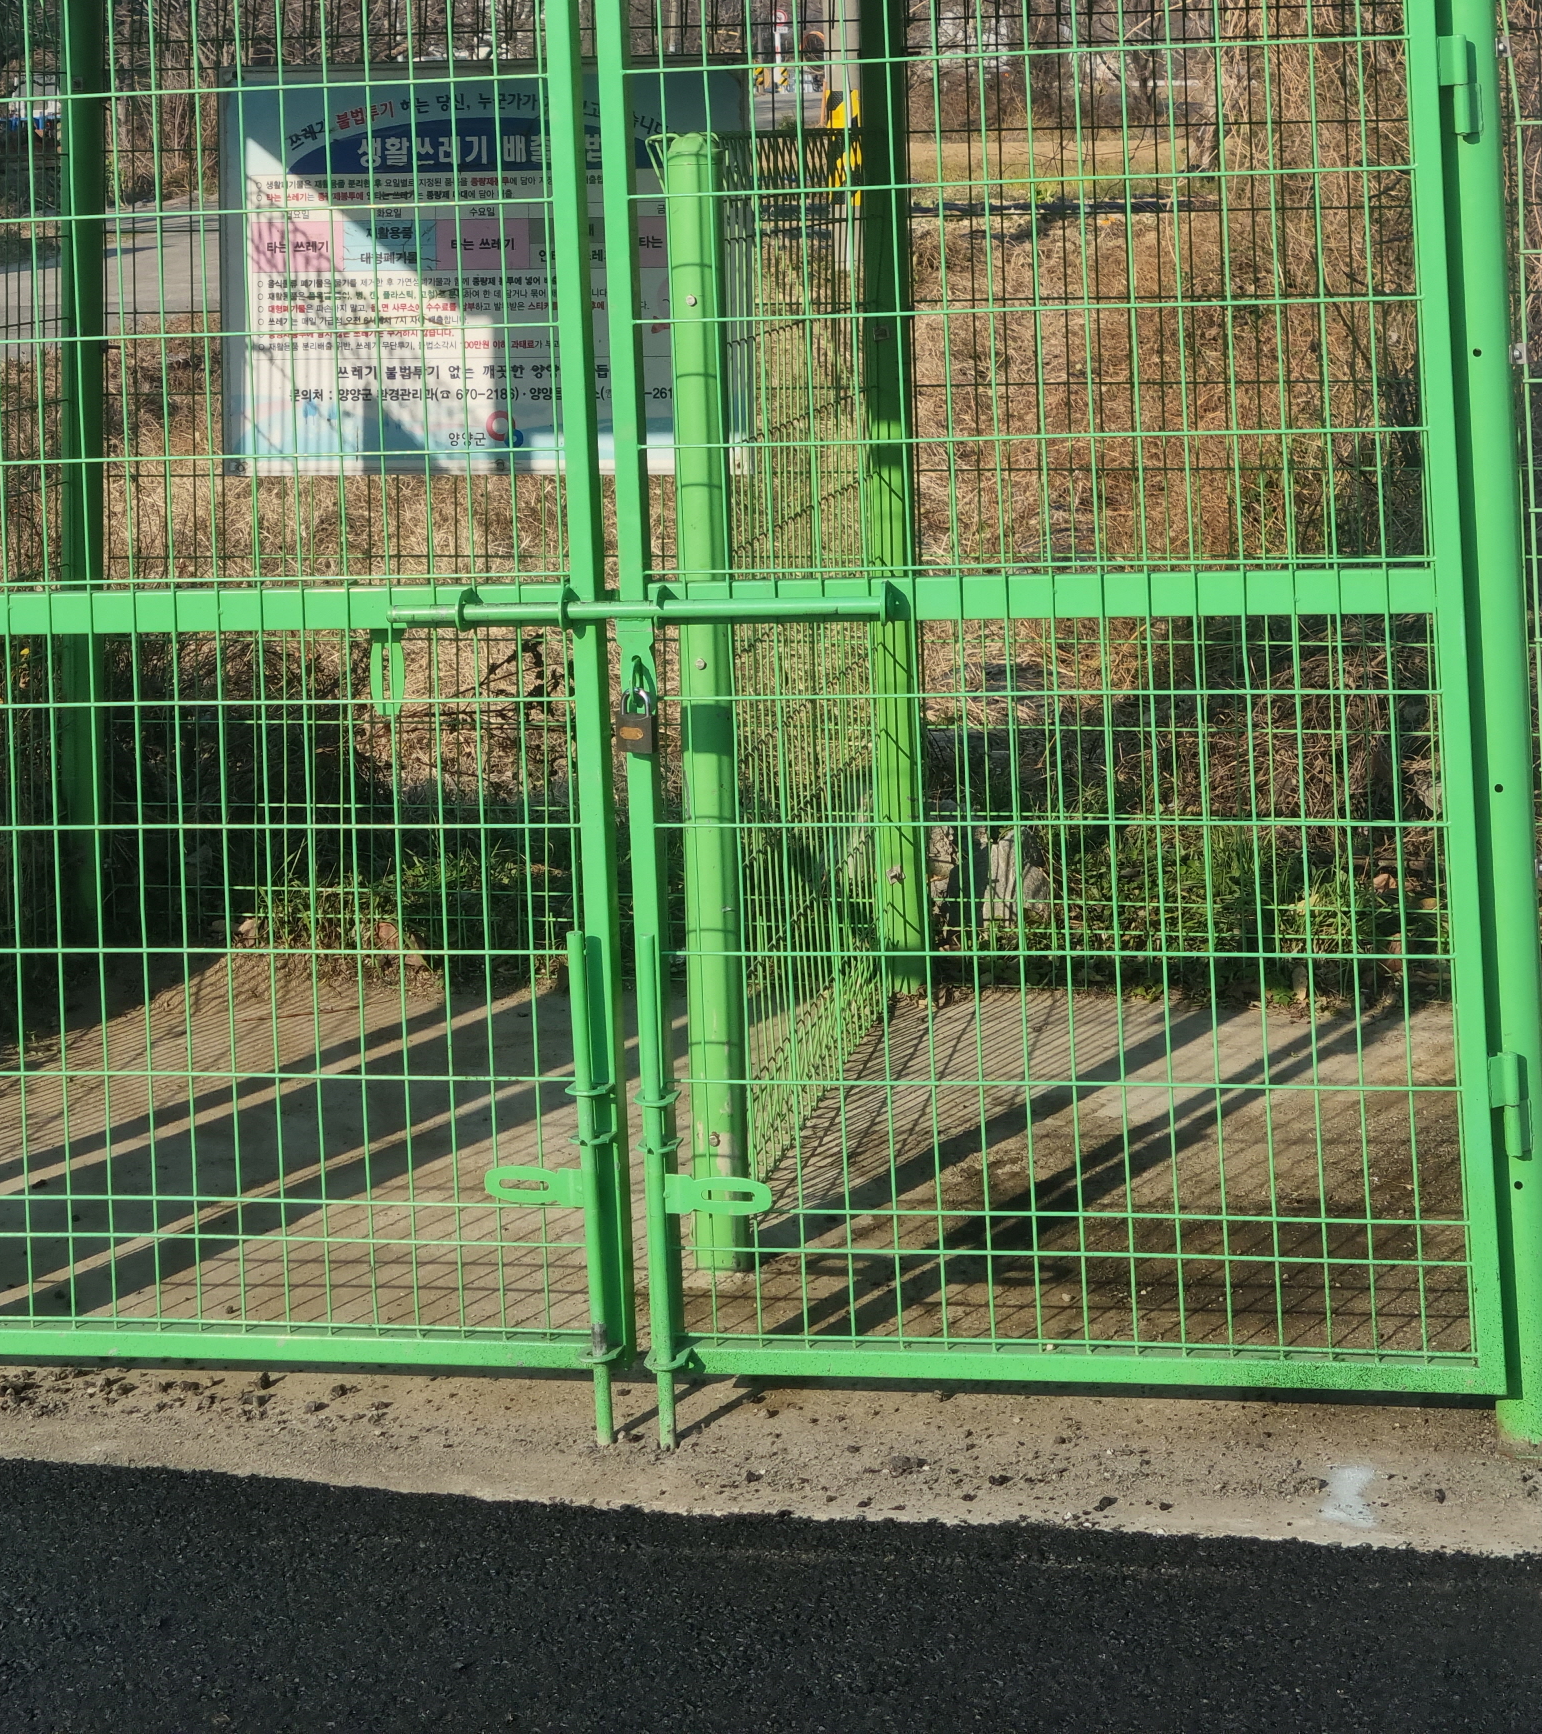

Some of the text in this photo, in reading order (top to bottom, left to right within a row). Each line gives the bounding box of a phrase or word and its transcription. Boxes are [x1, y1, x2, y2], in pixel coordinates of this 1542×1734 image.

[357, 135, 488, 167] 생활쓰레기
[377, 208, 401, 218] 화요일
[470, 207, 495, 217] 수요일
[294, 240, 329, 253] 쓰레기
[337, 365, 378, 380] 쓰레기
[338, 387, 372, 402] 양양군
